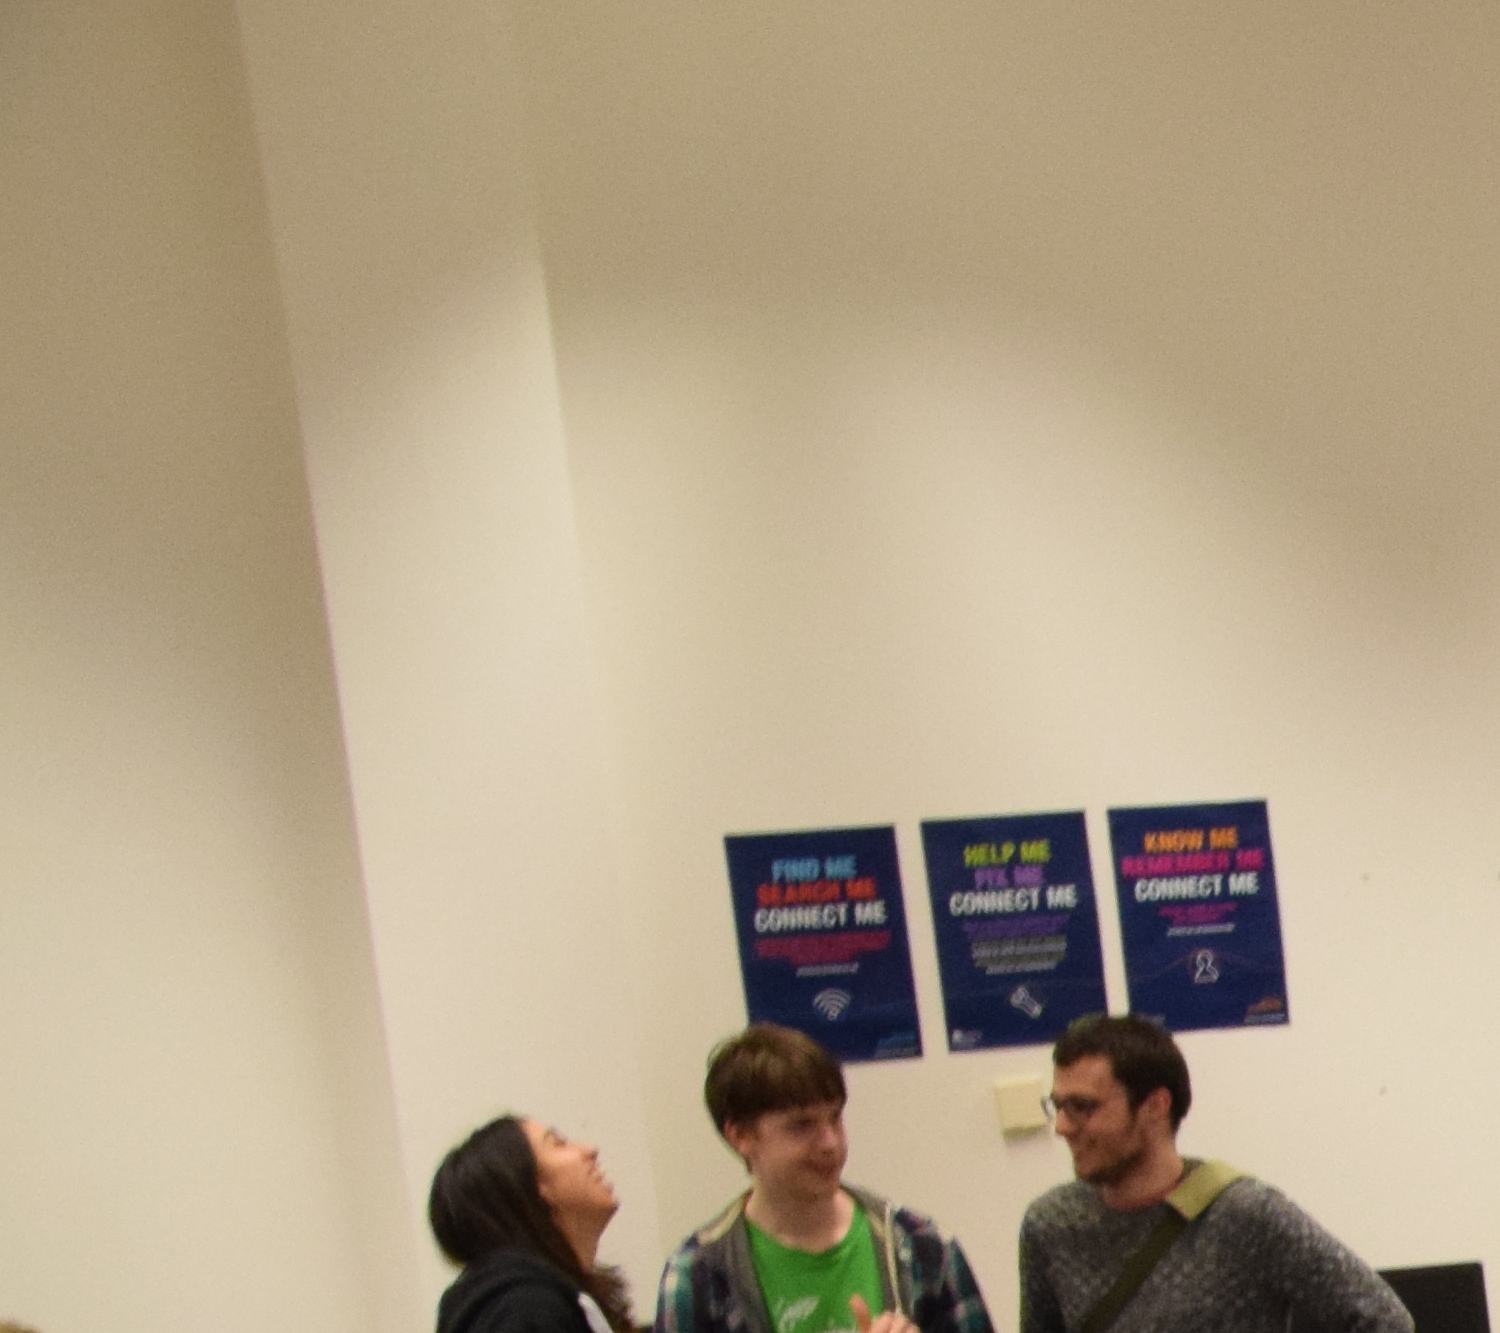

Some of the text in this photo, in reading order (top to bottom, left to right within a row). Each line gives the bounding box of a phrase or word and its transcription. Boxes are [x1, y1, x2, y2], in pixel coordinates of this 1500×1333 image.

[1144, 825, 1238, 853] KNOW ME
[963, 839, 1051, 868] HELP ME
[1235, 848, 1263, 871] ME
[771, 855, 857, 882] FIND ME
[845, 876, 877, 900] ME
[949, 884, 1078, 916] CONNECT ME
[1135, 871, 1259, 902] CONNECT ME
[754, 900, 887, 933] CONNECT ME
